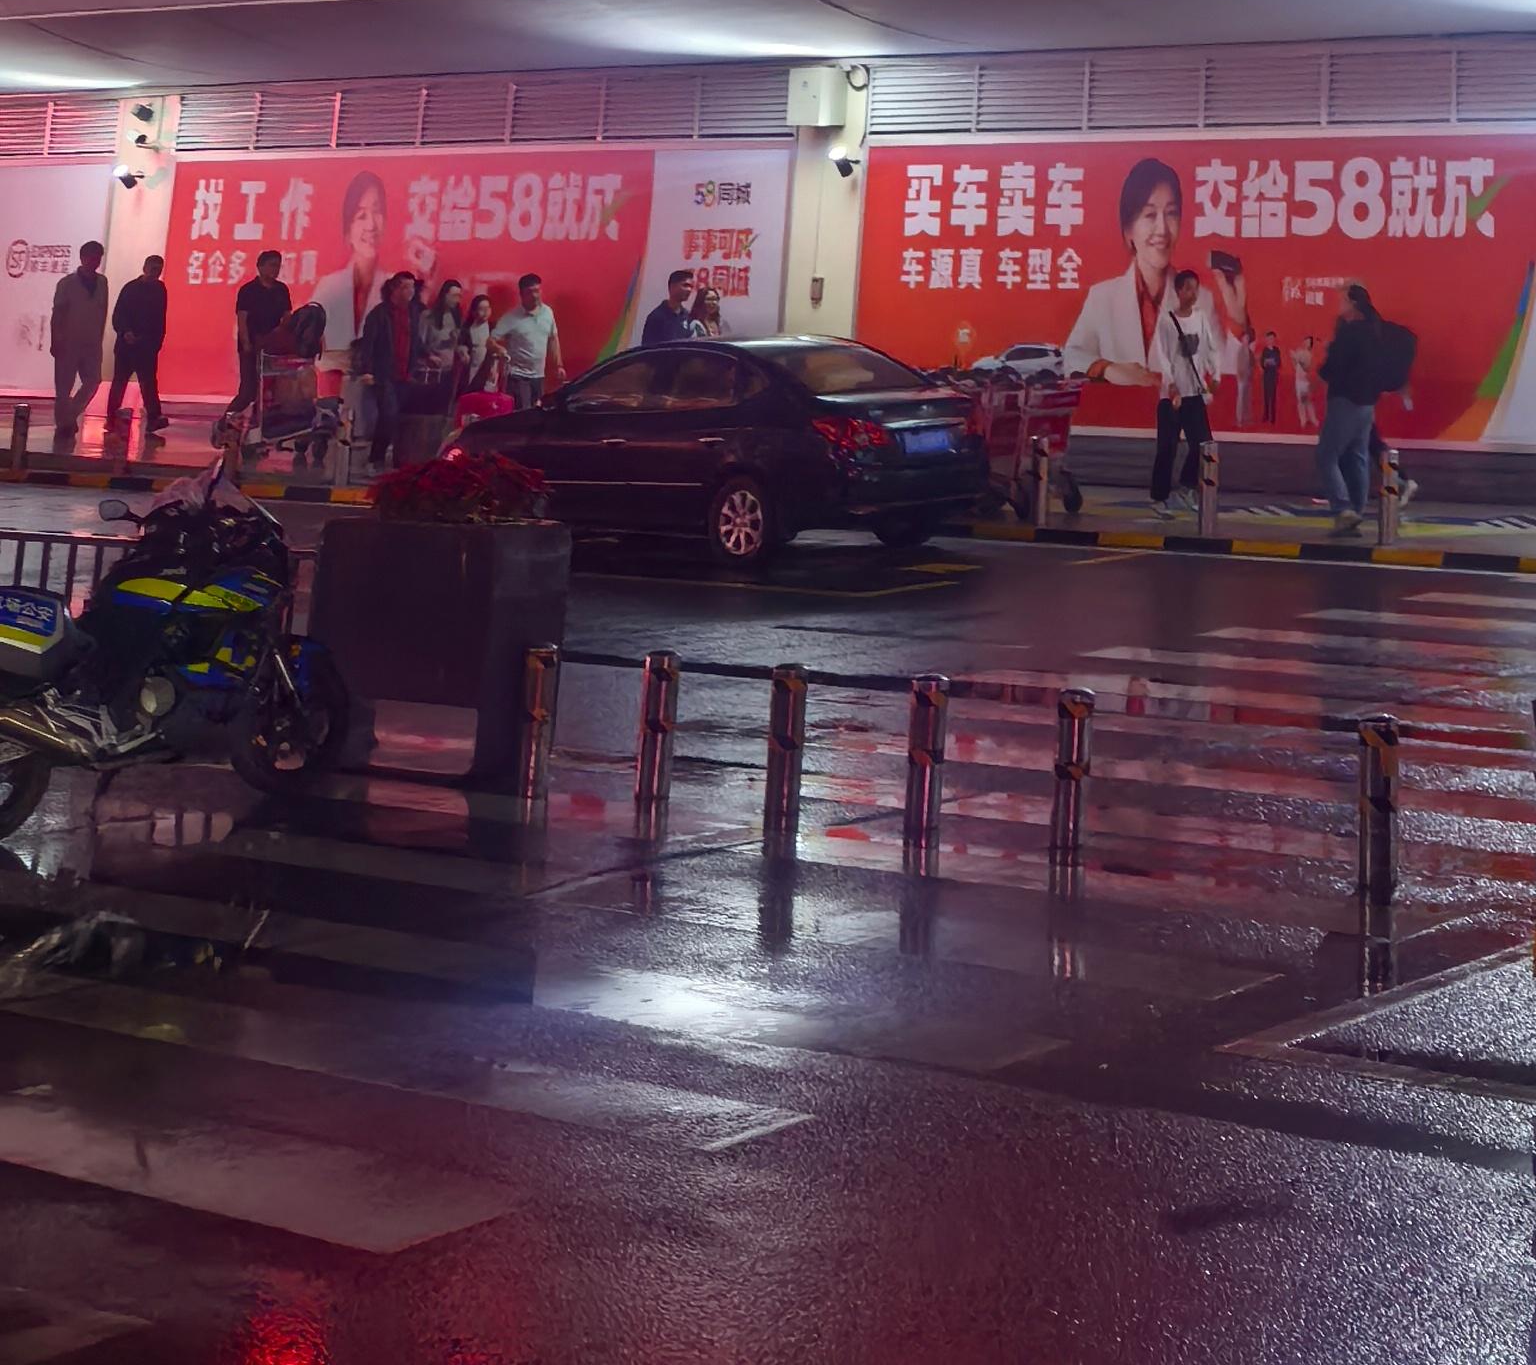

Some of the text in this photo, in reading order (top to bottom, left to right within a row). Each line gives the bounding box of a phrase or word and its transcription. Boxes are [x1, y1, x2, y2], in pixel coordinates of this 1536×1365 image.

[190, 177, 314, 241] 找工作
[694, 180, 752, 207] 58同城
[904, 156, 1495, 240] 买车卖车 交给58就成
[187, 249, 247, 285] 名企多
[688, 264, 751, 298] 8同城
[900, 247, 1083, 290] 车源真 车型全
